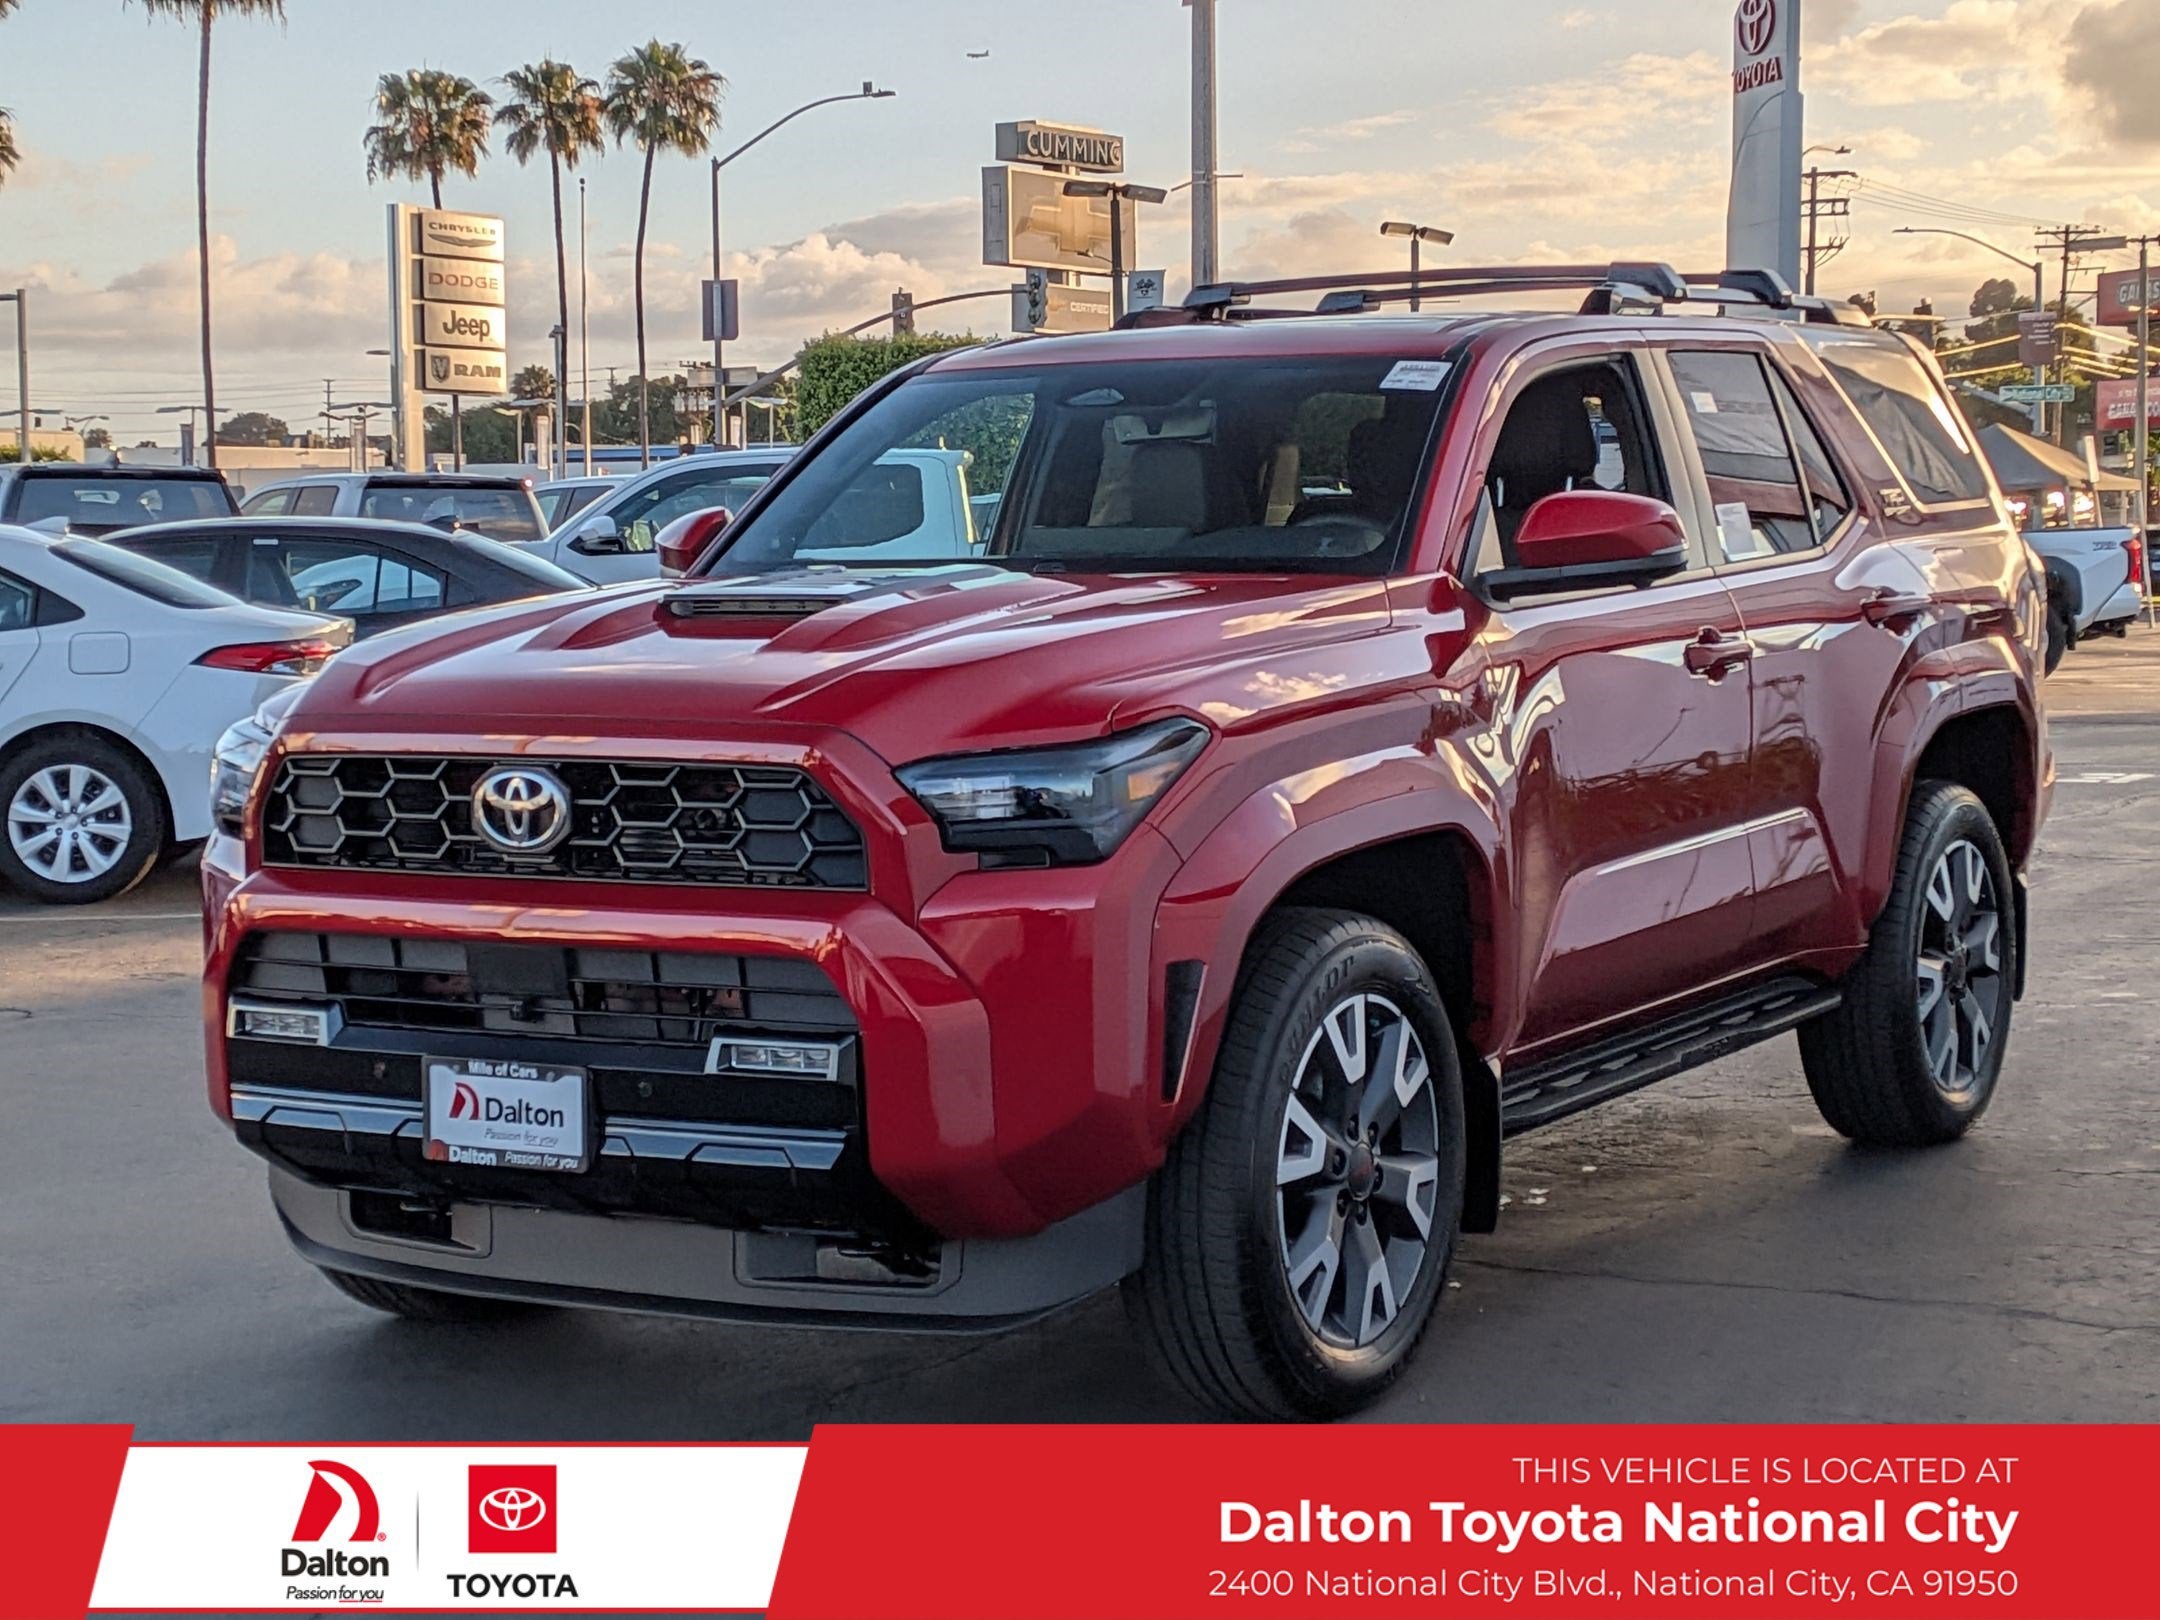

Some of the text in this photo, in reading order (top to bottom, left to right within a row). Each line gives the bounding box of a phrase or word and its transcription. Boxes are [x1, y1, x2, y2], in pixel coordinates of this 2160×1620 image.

[1026, 129, 1121, 166] CUMMING
[428, 221, 496, 236] CHRYSLER
[428, 272, 499, 290] DODGE
[442, 309, 490, 342] Jeep
[453, 363, 501, 379] RAM
[468, 1060, 539, 1079] Mile of Cars
[485, 1097, 564, 1128] Dalton
[484, 1127, 521, 1141] Passion
[450, 1146, 579, 1170] Dalton Passion for you
